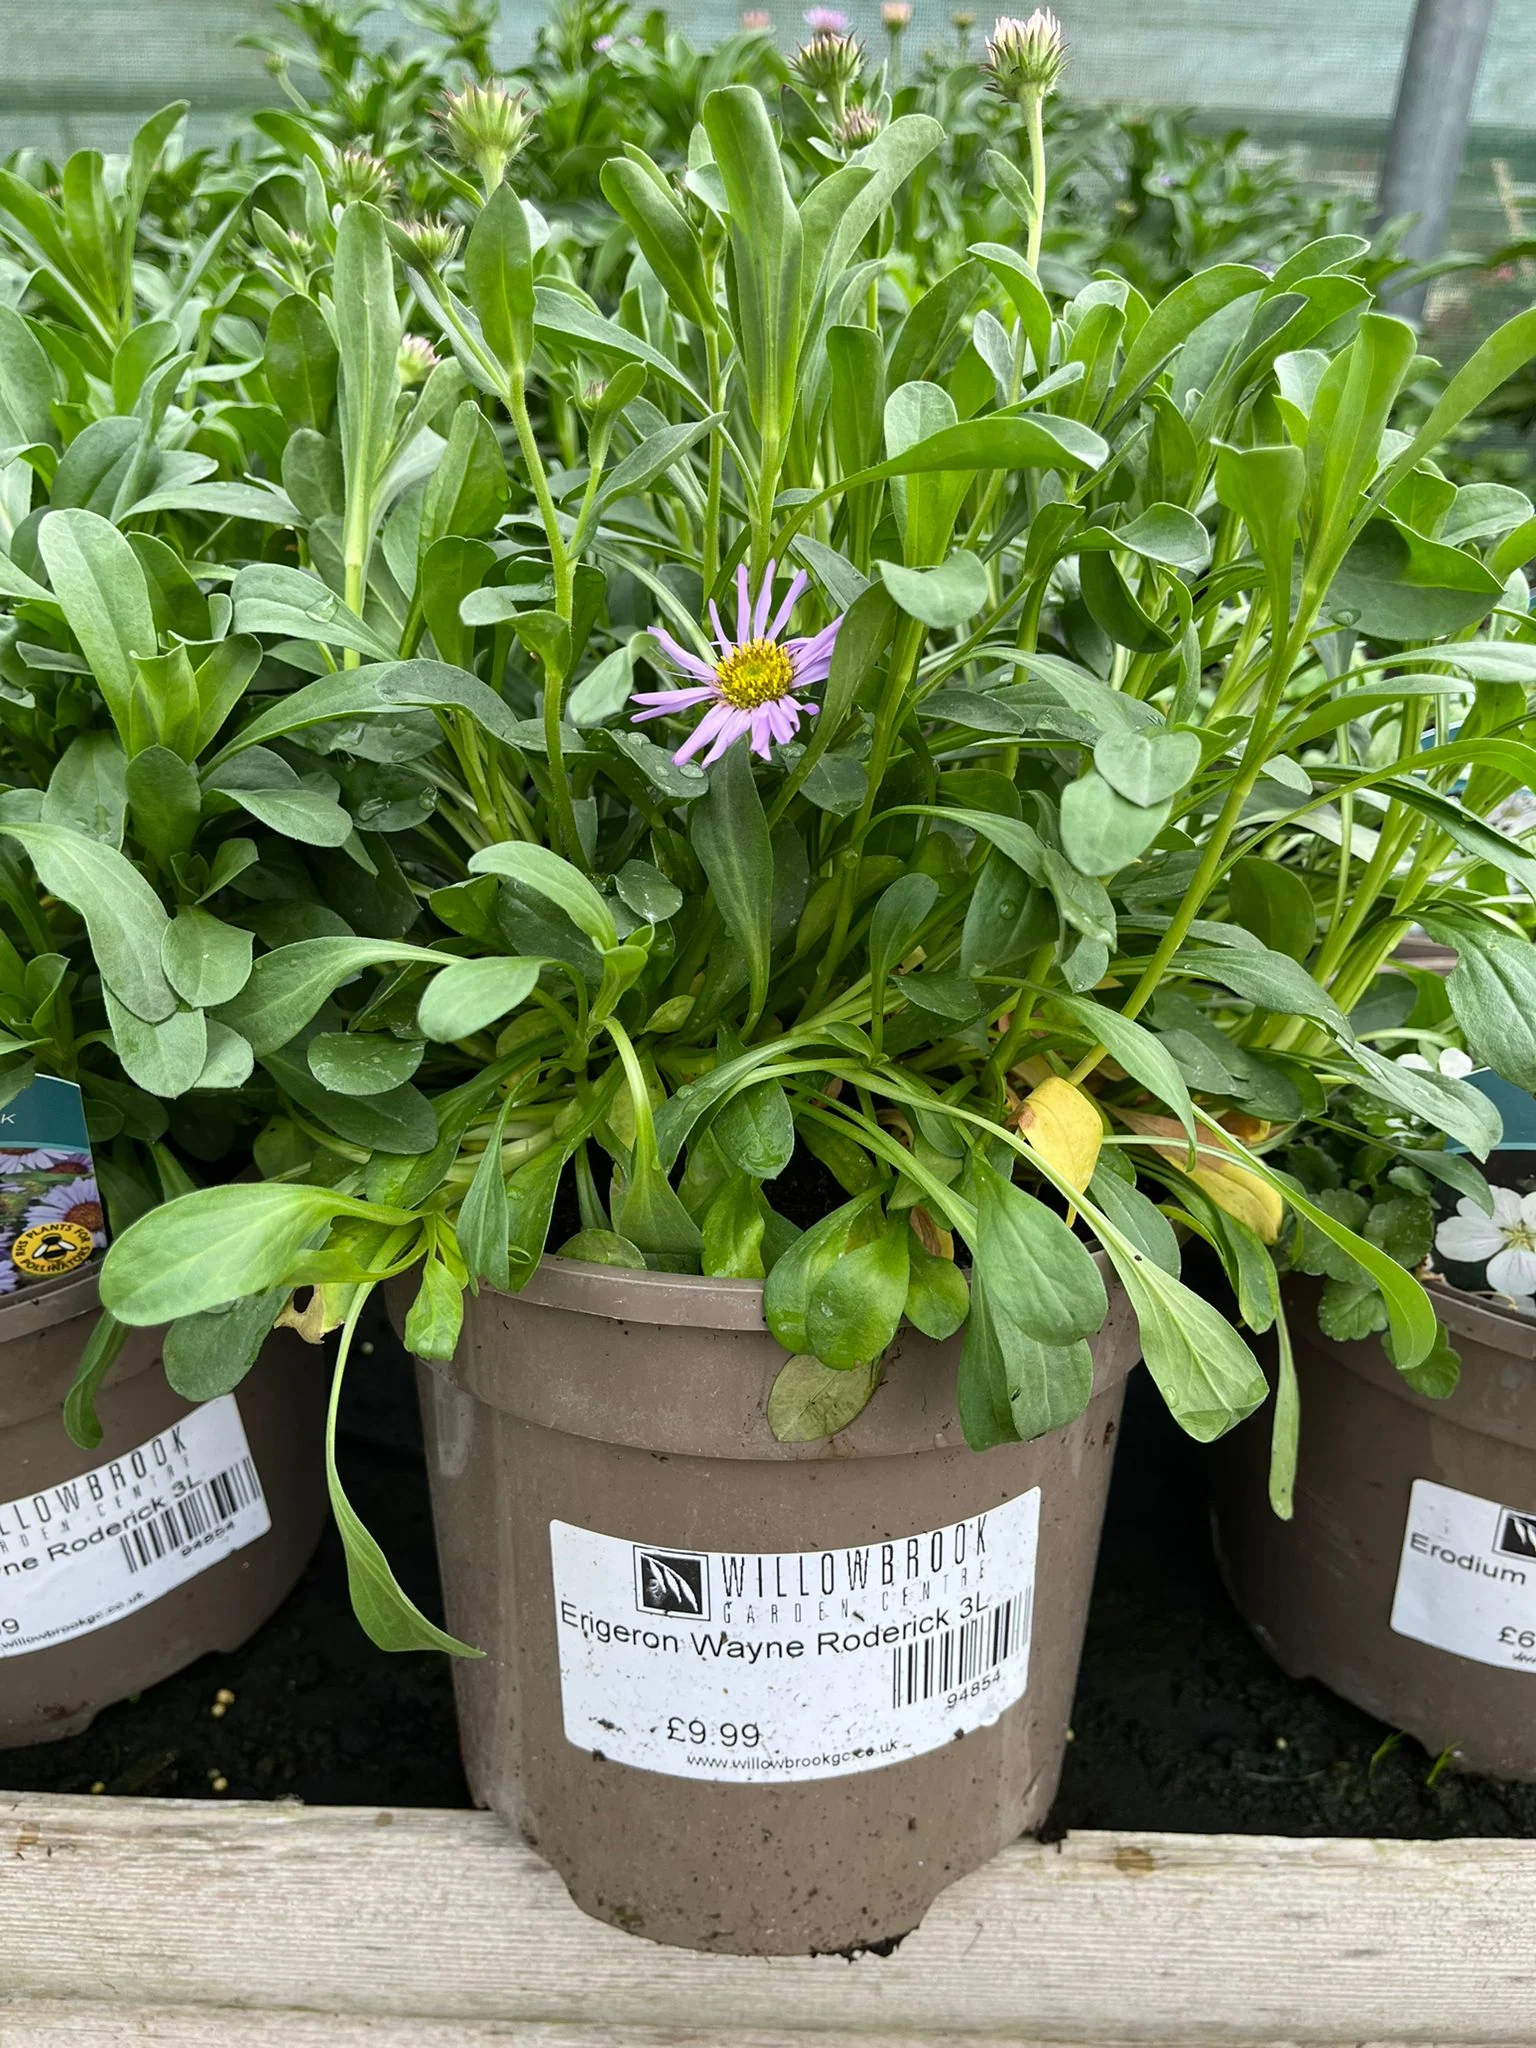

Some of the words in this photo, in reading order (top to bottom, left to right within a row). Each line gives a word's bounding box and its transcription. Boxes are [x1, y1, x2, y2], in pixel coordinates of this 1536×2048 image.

[15, 1240, 29, 1257] RHS
[26, 1223, 74, 1239] PLANTS
[74, 1227, 91, 1244] FOR
[20, 1245, 91, 1273] POLLINATORS
[0, 1557, 39, 1576] ne
[47, 1495, 167, 1562] Roderick
[171, 1475, 203, 1499] 3L
[721, 1514, 988, 1598] WILLOWBROOK
[1410, 1531, 1527, 1586] Erodium
[723, 1600, 849, 1624] GARDEN
[882, 1559, 985, 1612] CENTRE
[0, 1617, 20, 1635] 9
[561, 1600, 679, 1653] Erigeron
[690, 1631, 805, 1665] Wayne
[817, 1607, 951, 1656] Roderick
[959, 1590, 990, 1619] 3L
[946, 1670, 1002, 1710] 94854
[667, 1716, 760, 1748] £9.99
[687, 1738, 897, 1771] www.willowbrookgc.co.uk
